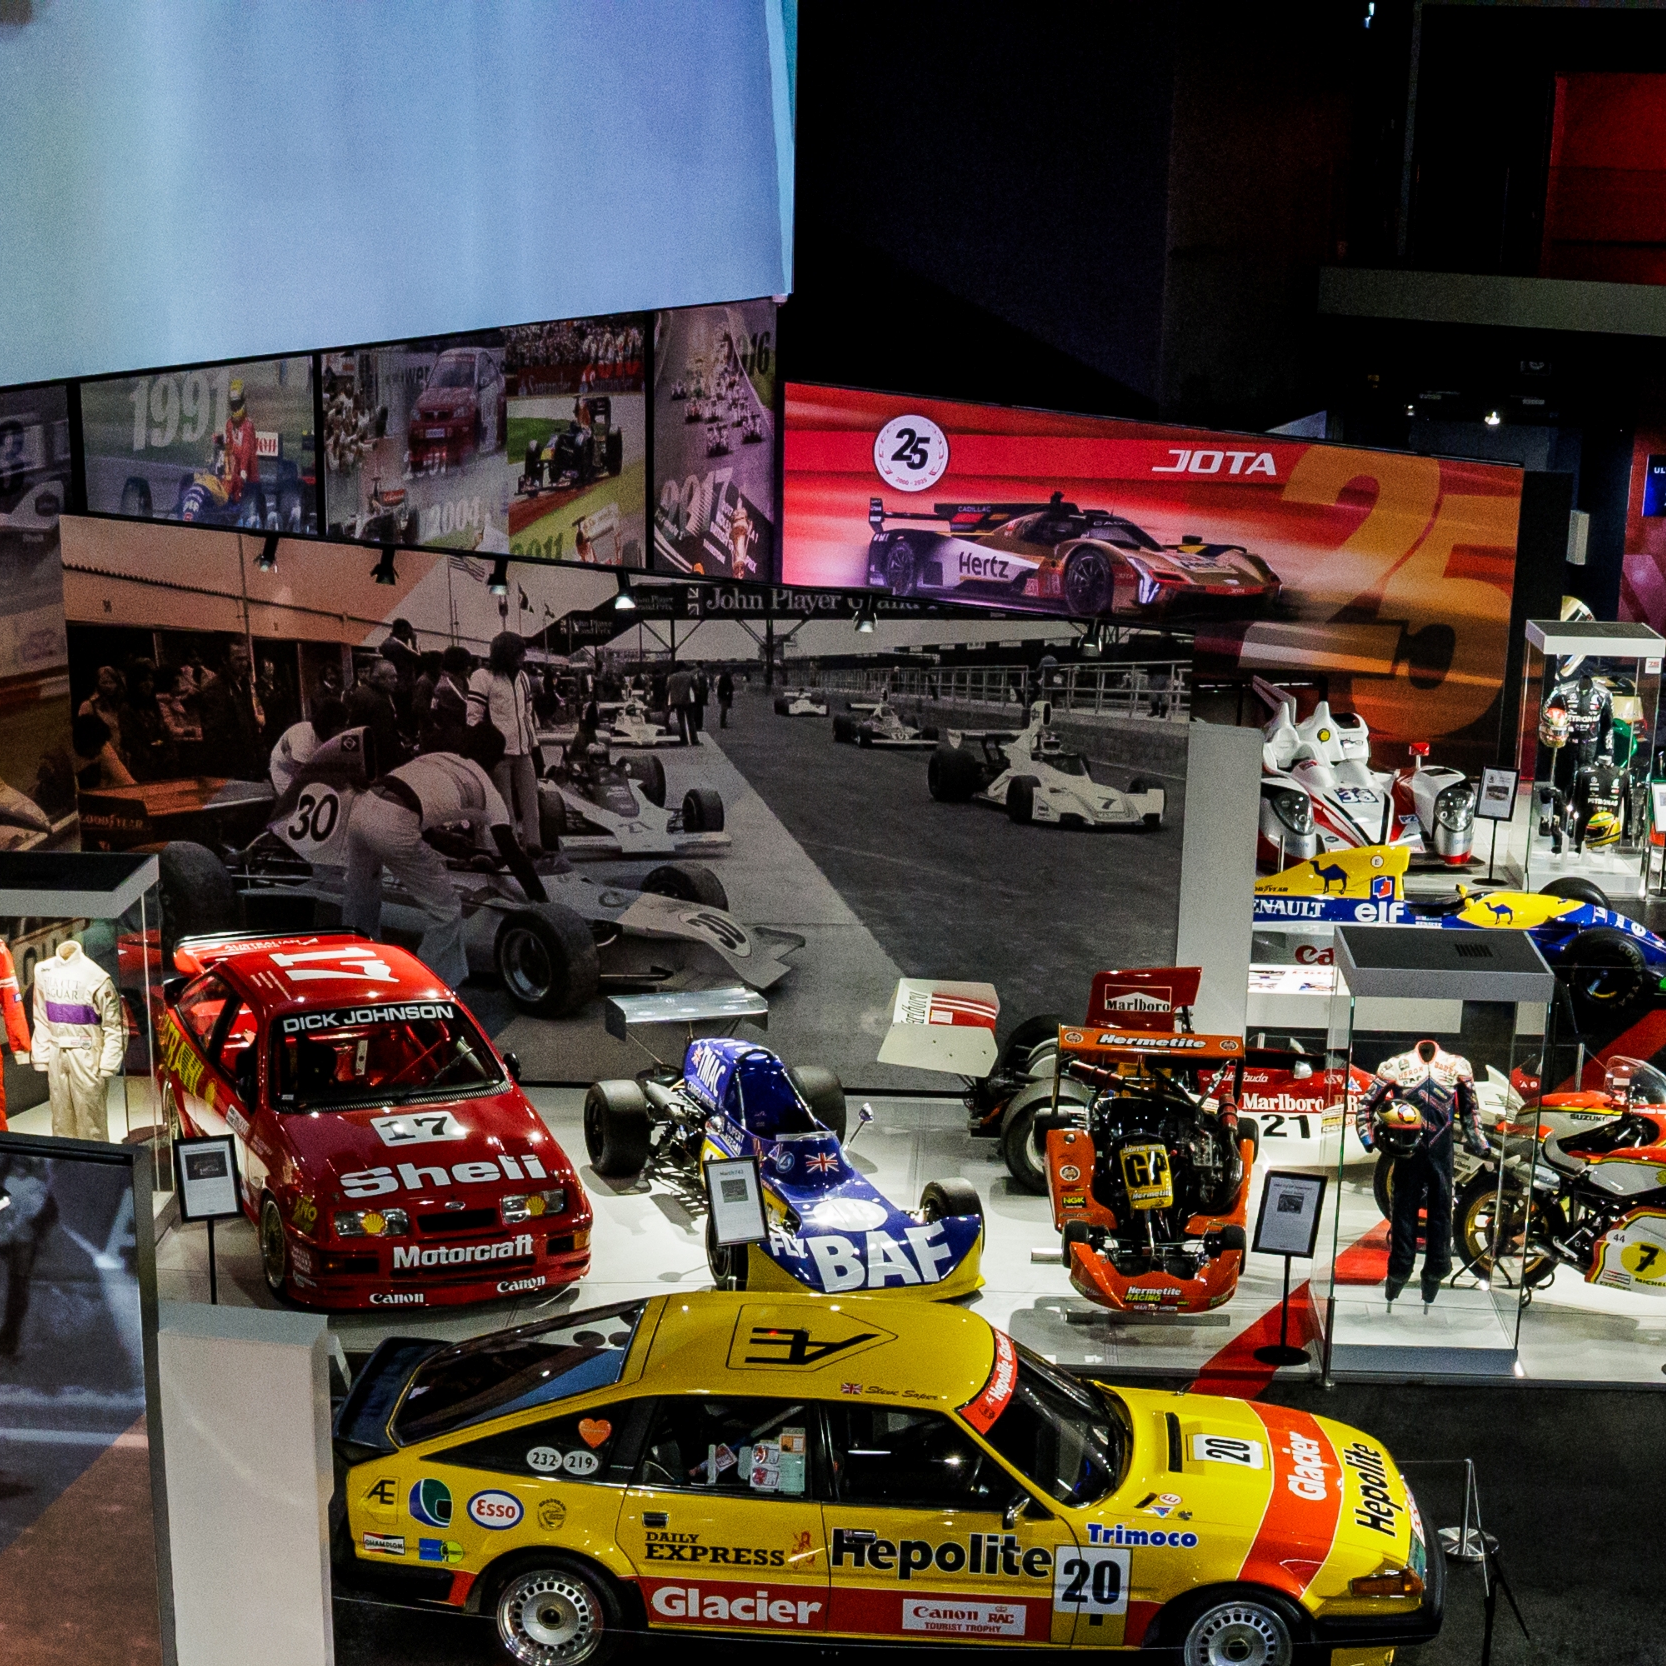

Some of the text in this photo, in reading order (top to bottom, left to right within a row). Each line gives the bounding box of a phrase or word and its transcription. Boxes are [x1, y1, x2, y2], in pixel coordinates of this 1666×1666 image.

[132, 367, 232, 452] 1991
[891, 428, 930, 471] 25
[1151, 449, 1276, 476] JOTA
[957, 504, 992, 513] CADILLAC
[958, 551, 1010, 580] Hertz
[706, 588, 764, 611] John
[772, 587, 841, 613] Player
[1098, 796, 1119, 811] 7
[287, 793, 340, 842] 30
[1373, 857, 1381, 866] E
[1254, 899, 1326, 918] ENAULT
[1354, 902, 1407, 924] elf
[695, 911, 742, 953] 30
[270, 946, 401, 984] 17
[44, 989, 81, 1001] AGUAR
[900, 990, 929, 1025] arlboro
[1105, 998, 1171, 1012] Marlboro
[283, 1003, 455, 1034] DICK JOHNSON
[1099, 1034, 1207, 1049] Hermetite
[696, 1044, 727, 1098] TMAC
[1242, 1092, 1325, 1112] Marlboro
[379, 1115, 450, 1142] 17
[1260, 1113, 1311, 1140] 21
[1569, 1112, 1606, 1122] SUZUKI
[340, 1153, 549, 1198] Shell
[1124, 1150, 1168, 1190] GP
[1062, 1196, 1086, 1205] NGK
[393, 1233, 534, 1269] Motorcraft
[1612, 1234, 1626, 1245] 44
[769, 1219, 952, 1294] FLY BAF
[1635, 1244, 1660, 1273] 7
[496, 1274, 546, 1294] Canon
[1127, 1285, 1182, 1297] Hermetite
[368, 1292, 425, 1306] Canon
[1124, 1293, 1162, 1303] RACING
[989, 1356, 1015, 1402] Hepolite
[865, 1385, 939, 1402] Steve Soper
[531, 1451, 557, 1467] 232
[569, 1455, 593, 1469] 219
[1204, 1437, 1252, 1464] 20
[1281, 1431, 1327, 1501] Glacier
[1341, 1441, 1405, 1539] Hepolite
[363, 1537, 405, 1550] CHAMPION
[644, 1531, 701, 1546] DAILY
[1087, 1522, 1199, 1549] Trimoco
[644, 1543, 787, 1568] EXPRESS
[830, 1526, 1054, 1582] Hepolite
[1061, 1556, 1123, 1605] 20
[650, 1585, 824, 1626] Glacier
[912, 1605, 1015, 1625] Canon RAC
[924, 1621, 1002, 1633] TOURIST TROPHY
